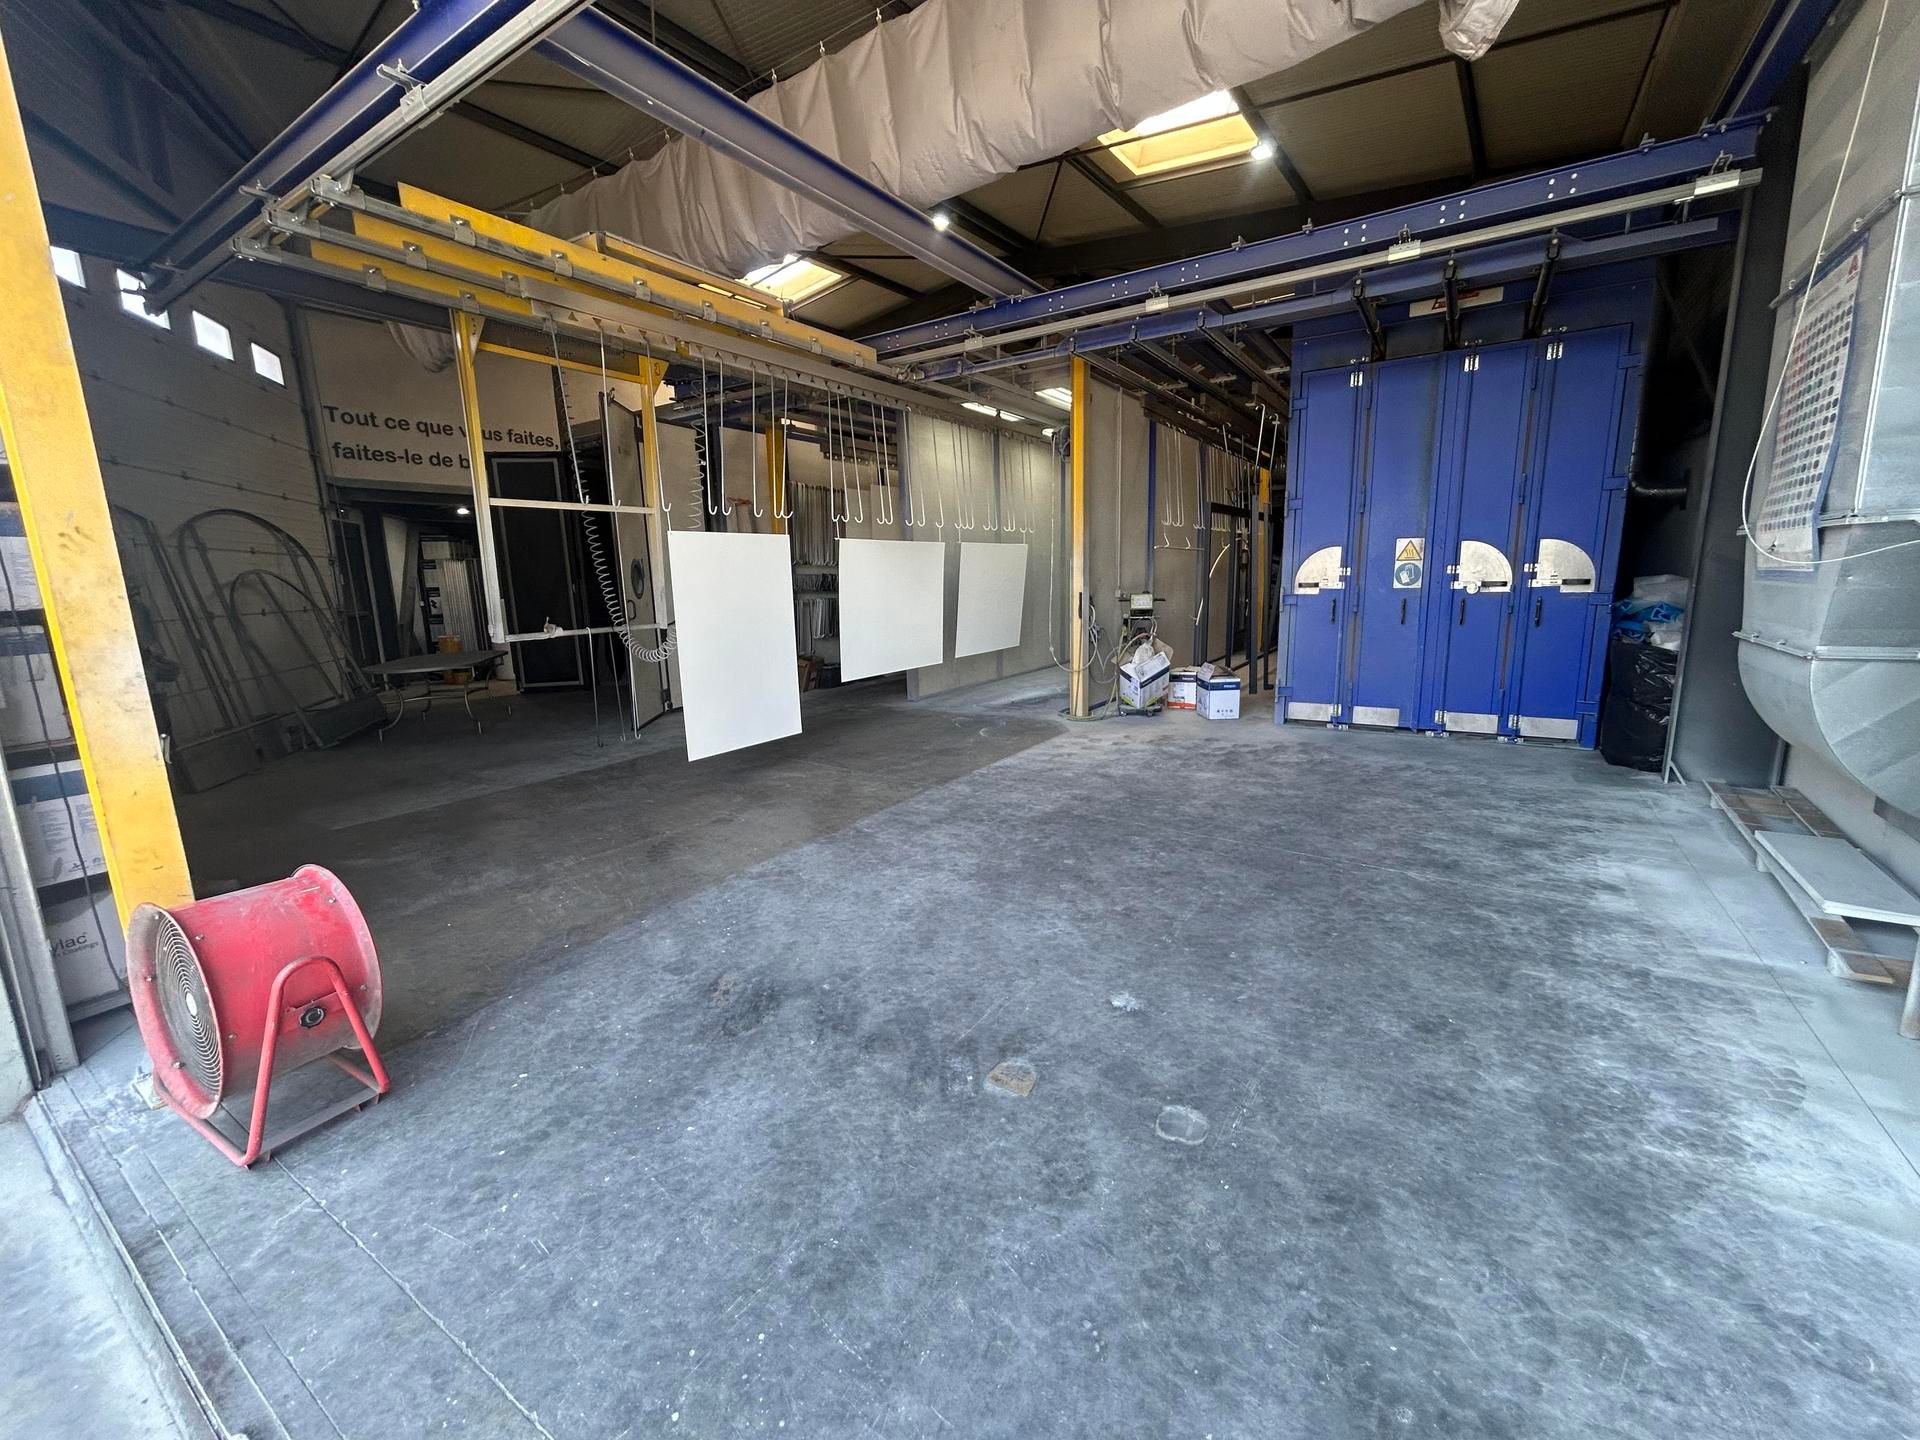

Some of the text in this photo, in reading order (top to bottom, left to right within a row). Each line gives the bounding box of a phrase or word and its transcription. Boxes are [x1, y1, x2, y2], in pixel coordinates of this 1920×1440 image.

[323, 405, 560, 450] Tout ce que vus faites,
[332, 442, 423, 465] faites-le
[428, 451, 454, 468] de
